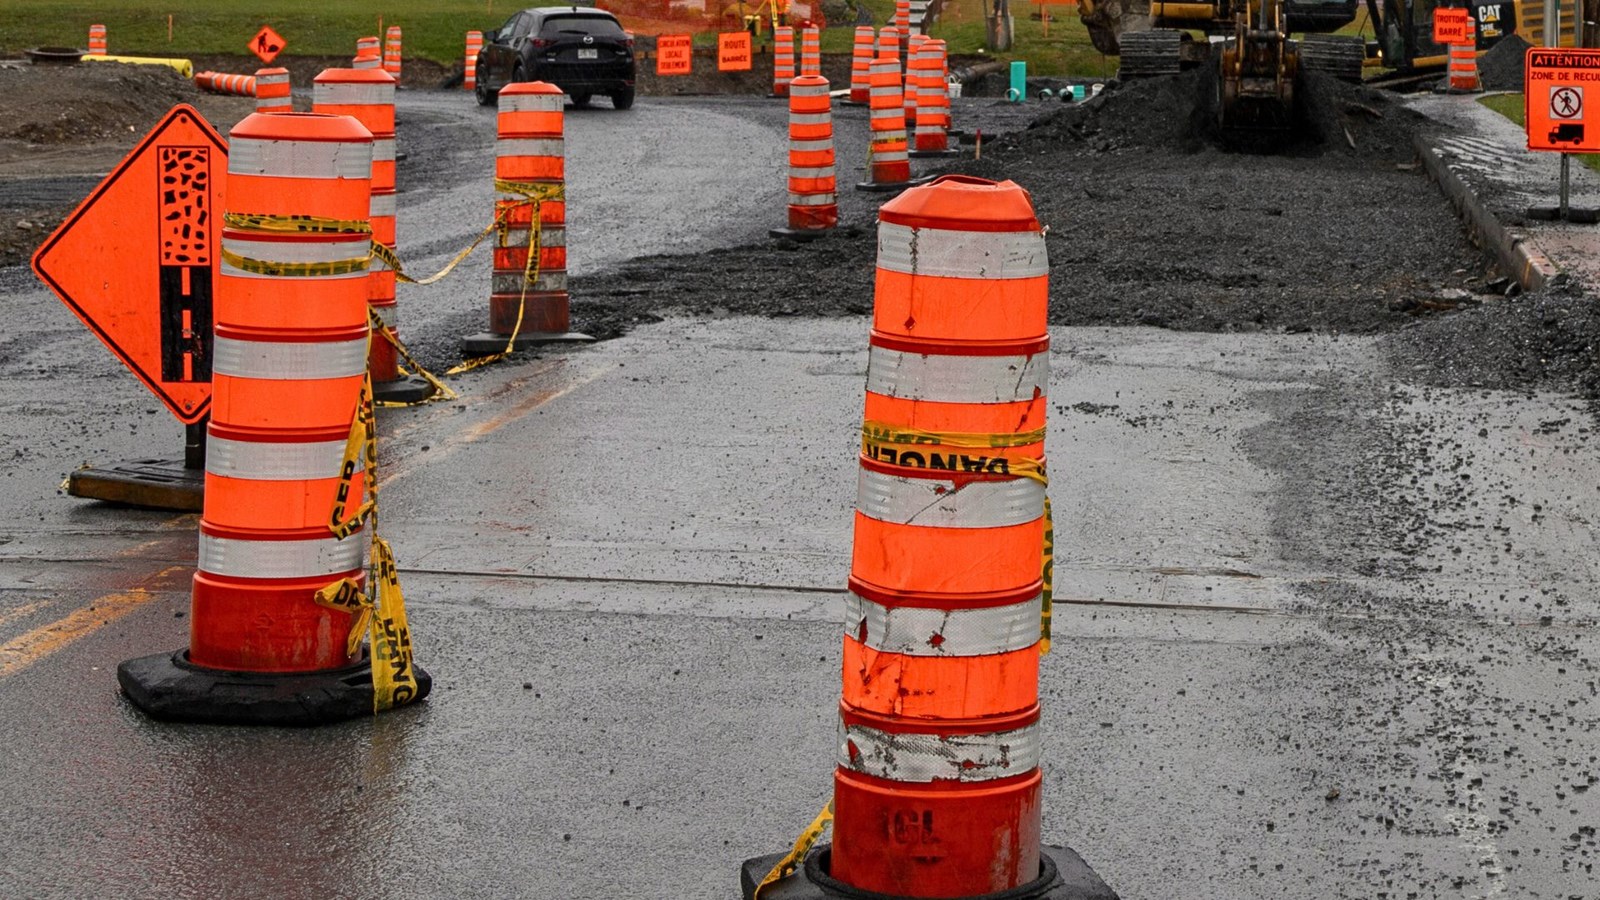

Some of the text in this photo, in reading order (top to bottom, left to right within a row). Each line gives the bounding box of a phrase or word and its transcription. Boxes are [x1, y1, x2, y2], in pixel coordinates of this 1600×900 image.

[1478, 4, 1501, 22] CAT
[1436, 15, 1466, 24] TROTTOIR
[724, 40, 746, 49] ROUTE
[1535, 55, 1600, 66] ATTENTION
[1531, 72, 1554, 80] ZONE
[1558, 72, 1570, 81] DE
